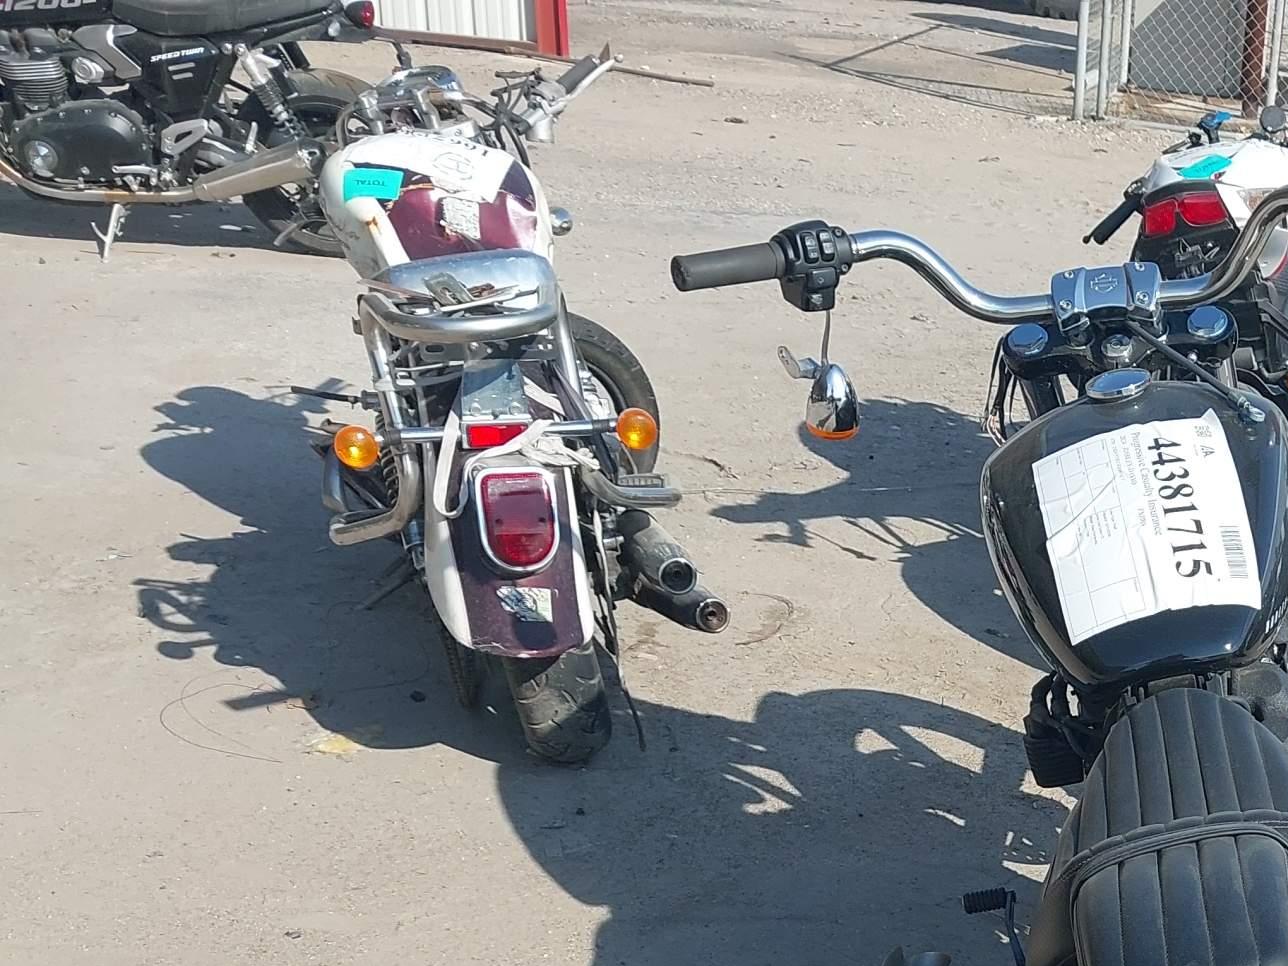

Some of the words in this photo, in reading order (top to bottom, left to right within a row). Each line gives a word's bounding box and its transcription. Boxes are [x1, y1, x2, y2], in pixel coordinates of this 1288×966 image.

[150, 51, 180, 62] SPEED
[181, 47, 204, 56] TWIN
[354, 179, 387, 187] TOTAL
[1131, 432, 1147, 467] Progressive
[1140, 468, 1155, 497] Casualty
[1148, 500, 1162, 536] Insurance
[1148, 437, 1213, 577] 44381715
